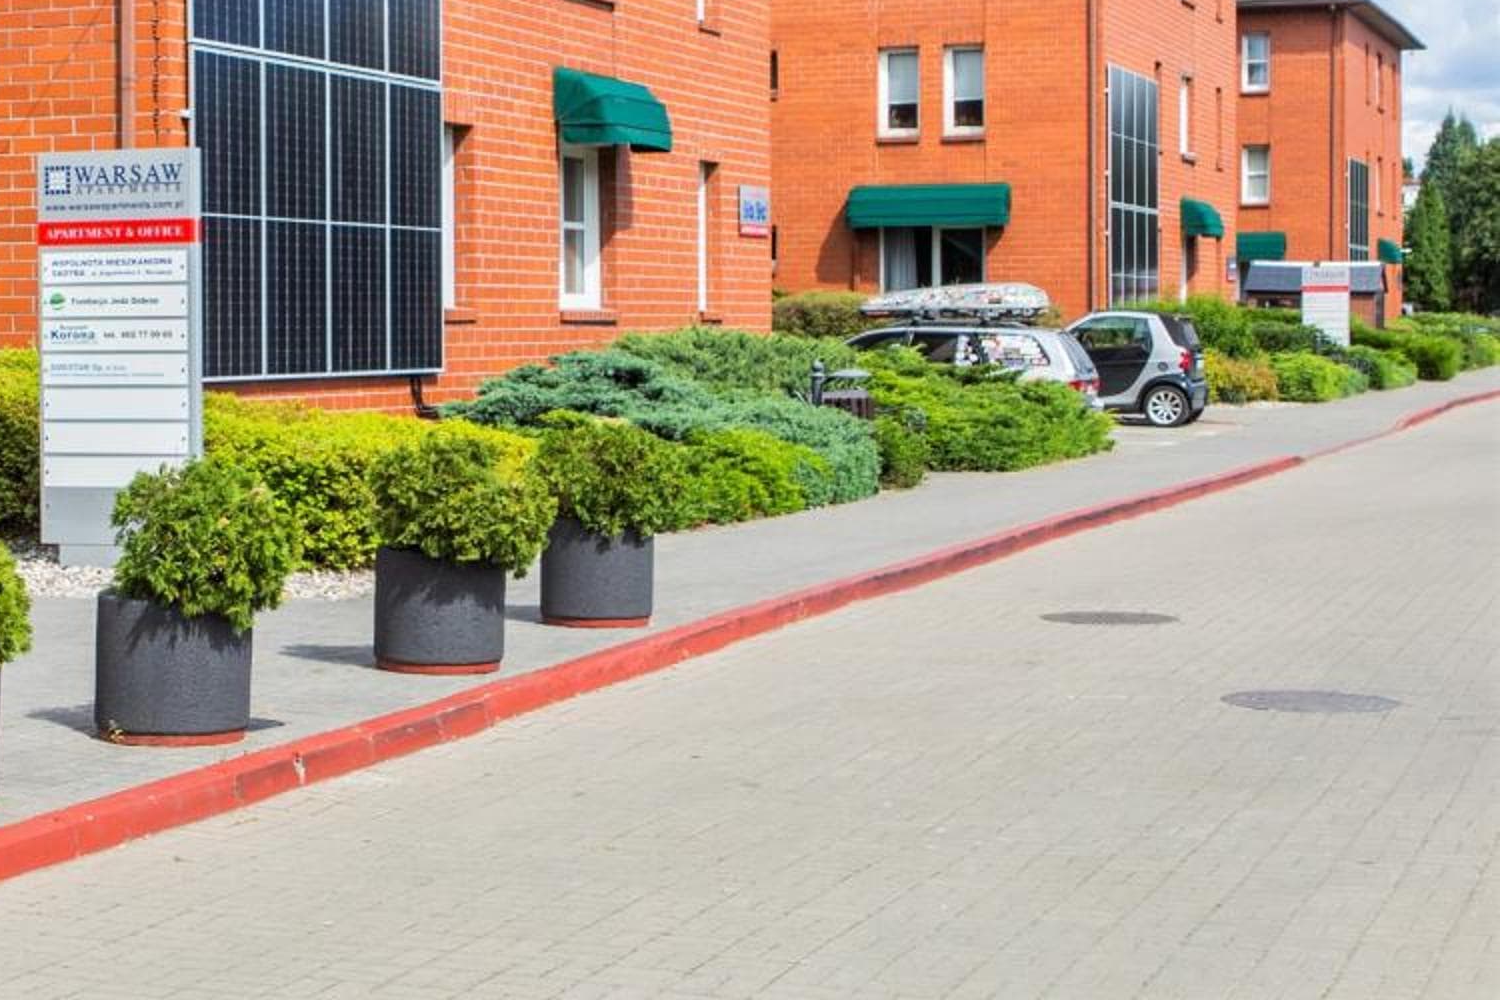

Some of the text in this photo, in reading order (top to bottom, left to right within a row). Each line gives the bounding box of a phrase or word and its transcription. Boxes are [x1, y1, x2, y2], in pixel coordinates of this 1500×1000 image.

[75, 163, 182, 185] WARSAW
[75, 183, 181, 195] APARTMENTS
[46, 225, 182, 240] APARTMENT & OFFICE
